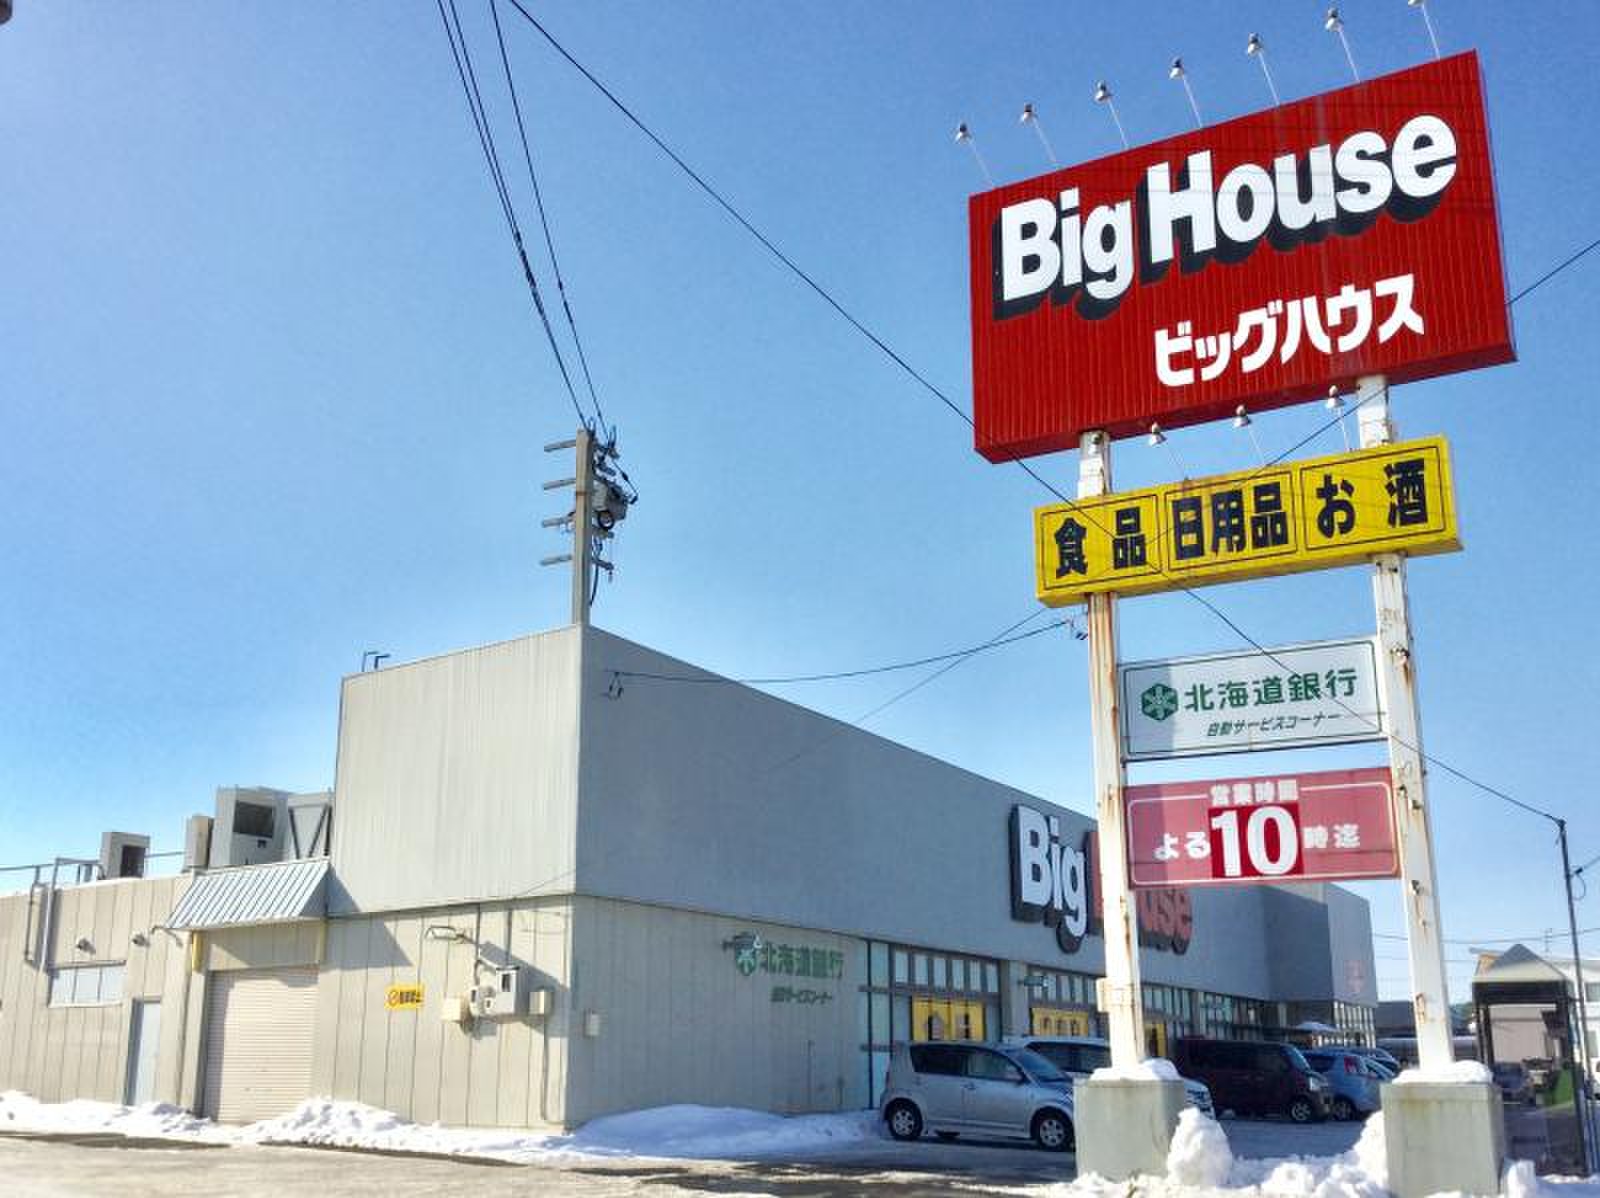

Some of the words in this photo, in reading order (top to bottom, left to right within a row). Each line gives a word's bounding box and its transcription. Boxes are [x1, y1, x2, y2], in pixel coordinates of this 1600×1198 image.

[1000, 186, 1134, 300] Big
[1147, 114, 1457, 265] House
[1154, 273, 1425, 387] ビッグハウス
[1054, 505, 1147, 579] 食品
[1172, 481, 1289, 560] 日用品
[1316, 458, 1429, 539] お酒
[1184, 668, 1358, 713] 北海道銀行
[1017, 805, 1088, 938] Big
